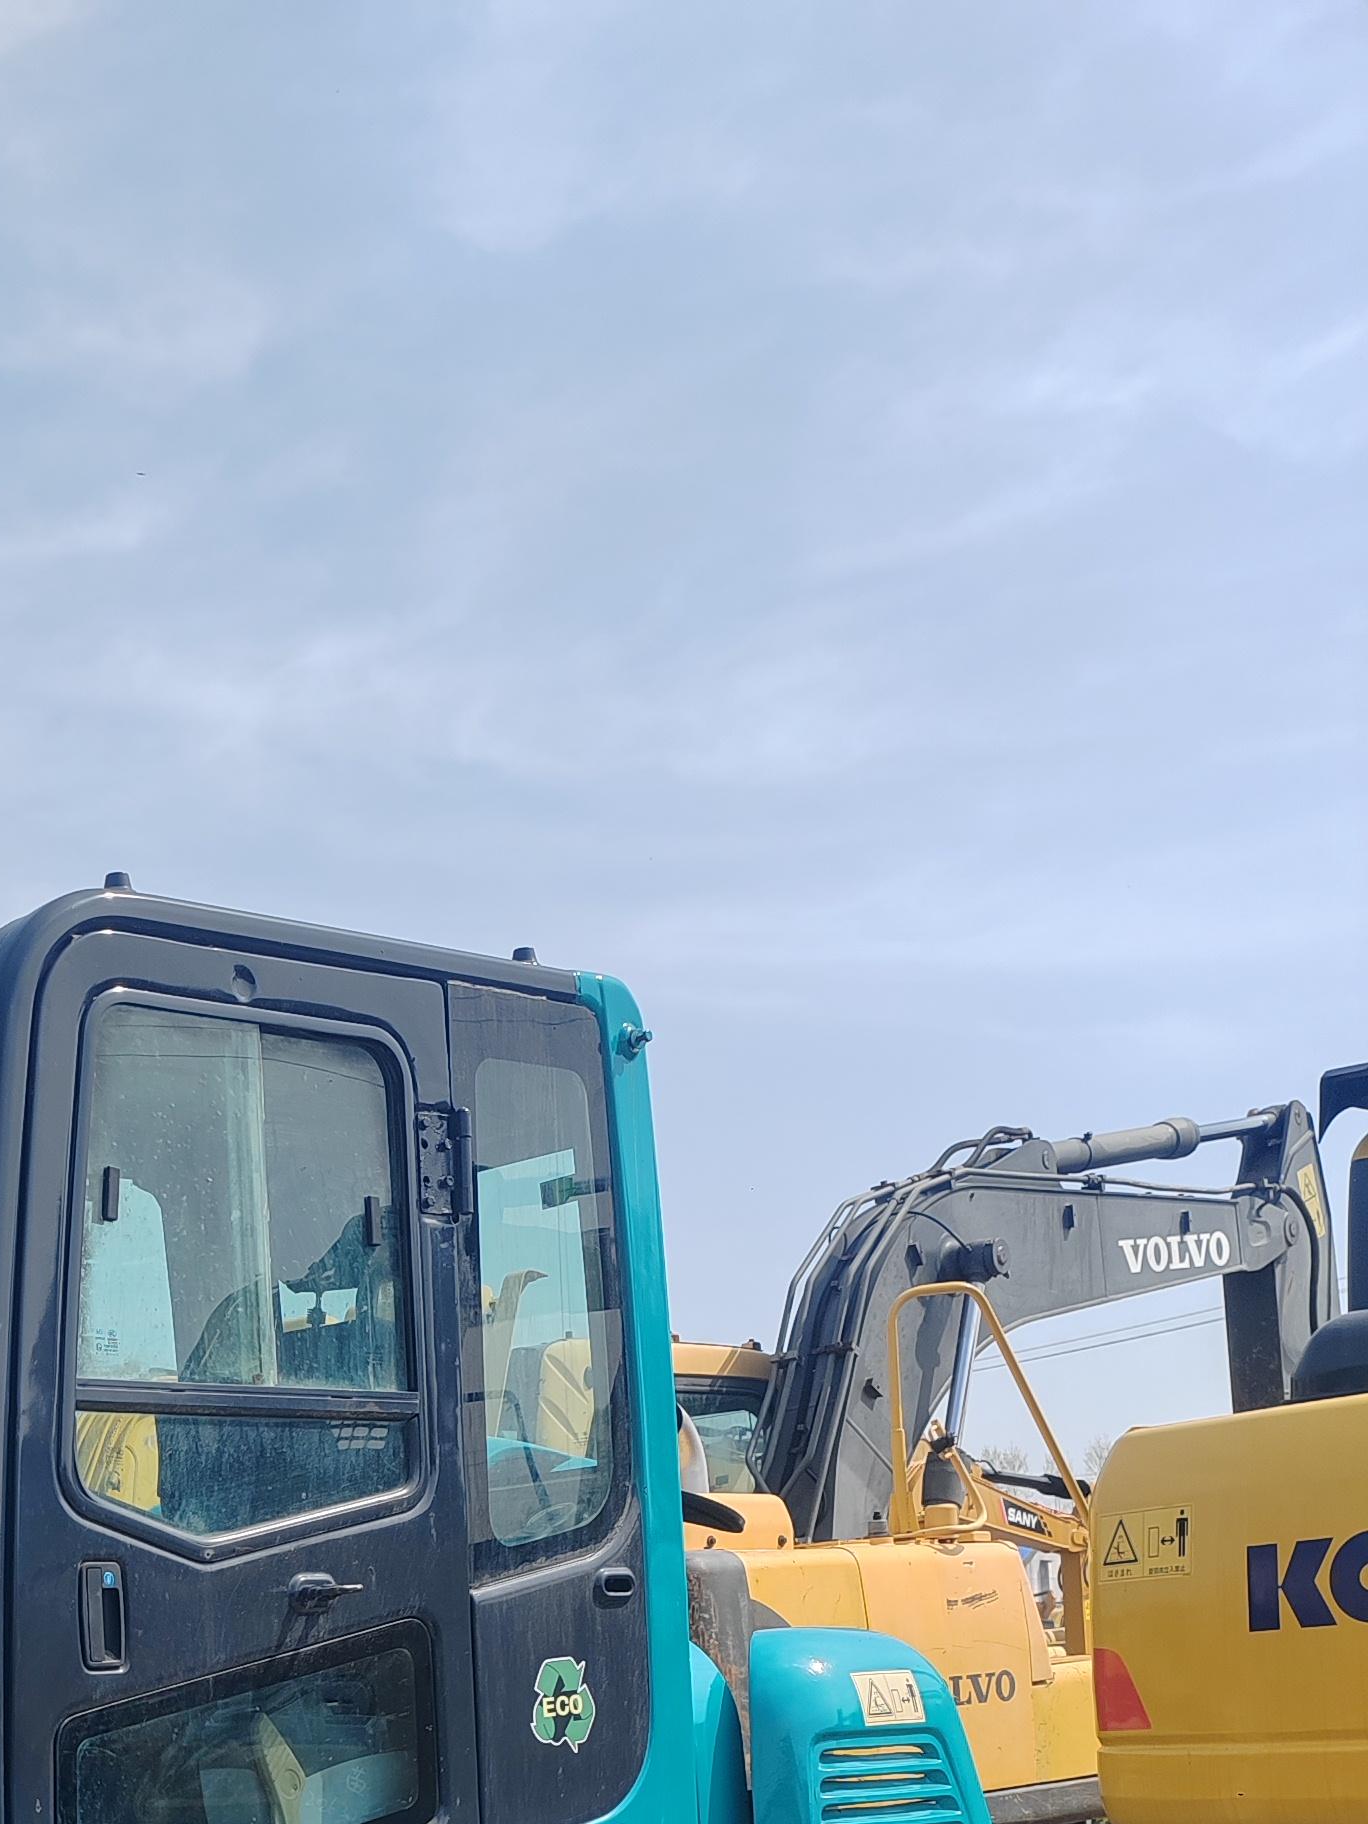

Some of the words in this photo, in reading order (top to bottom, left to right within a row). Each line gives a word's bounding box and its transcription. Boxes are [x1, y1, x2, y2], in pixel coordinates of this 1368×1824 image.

[1118, 1231, 1230, 1273] VOLVO
[1007, 1507, 1038, 1529] SANY
[948, 1669, 1016, 1706] LVO
[543, 1694, 583, 1718] ECO
